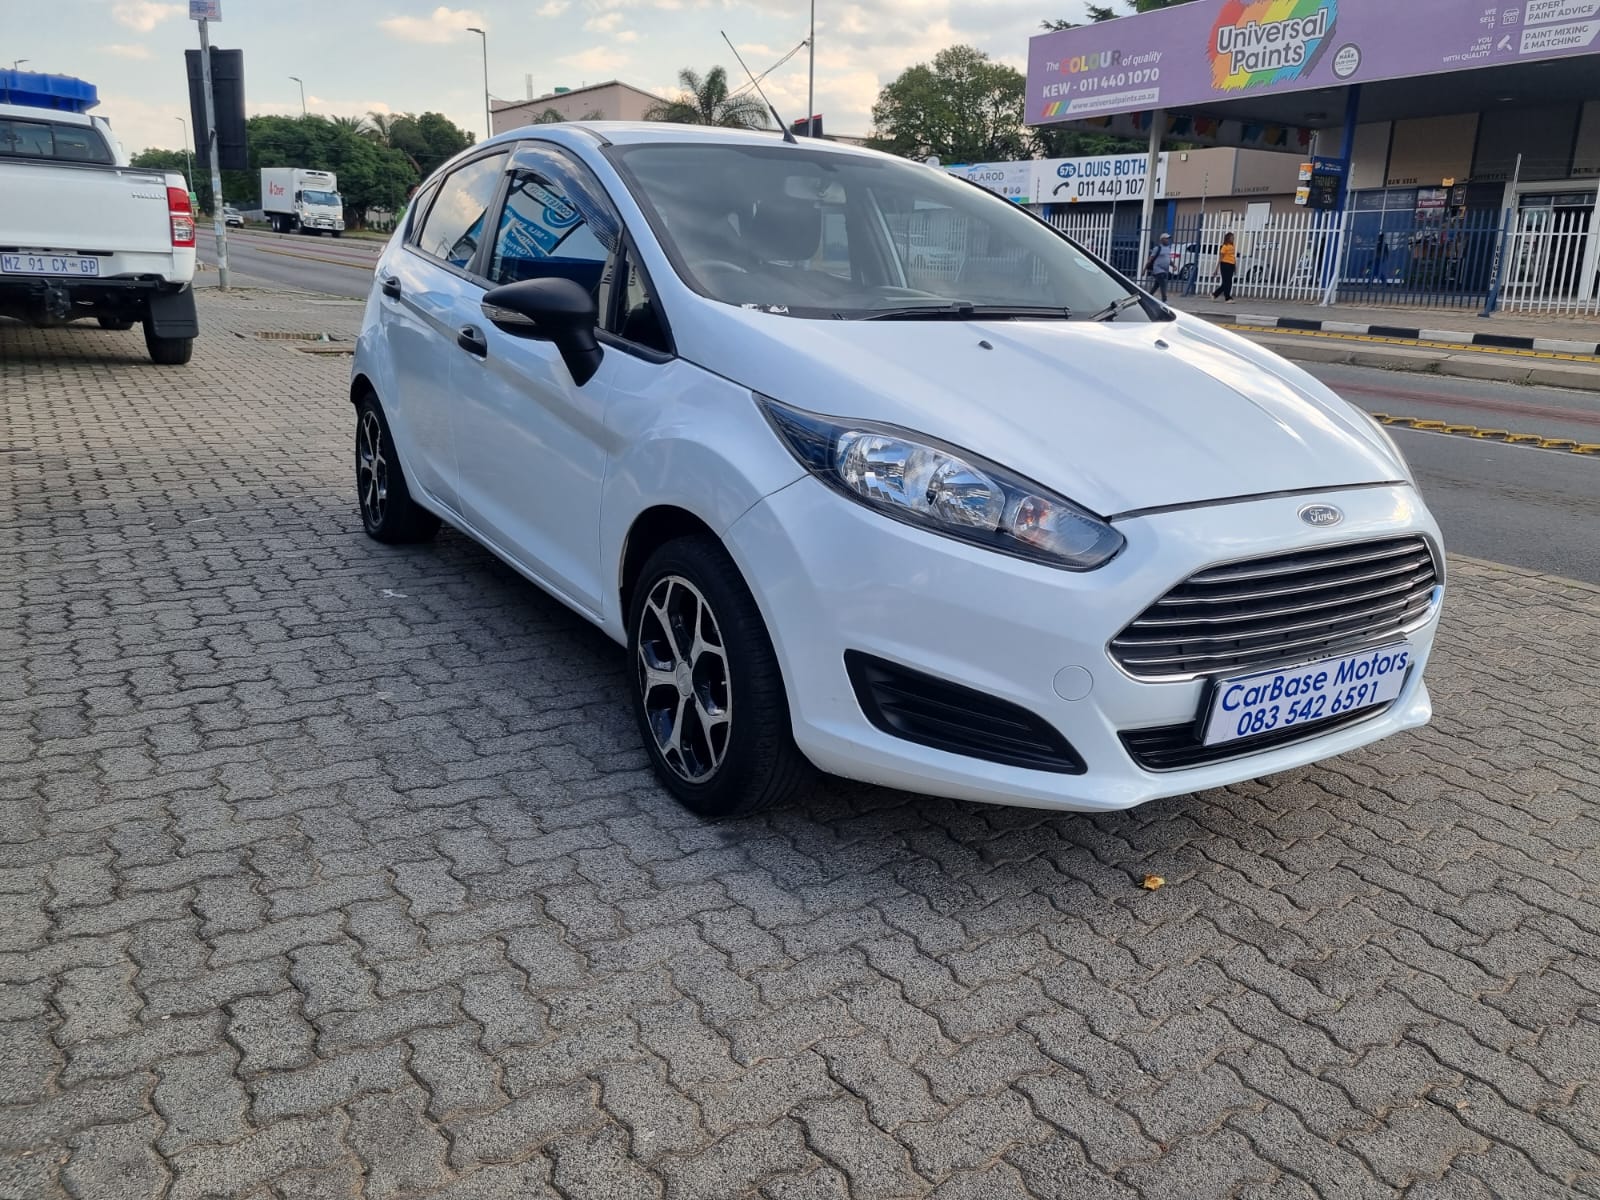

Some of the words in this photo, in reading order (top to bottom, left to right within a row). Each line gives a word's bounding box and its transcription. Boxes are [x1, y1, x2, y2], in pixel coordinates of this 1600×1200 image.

[1528, 10, 1556, 21] PAINT
[1558, 4, 1594, 16] ADVICE
[1529, 0, 1564, 11] EXPERT
[1218, 9, 1327, 52] Universal
[1525, 30, 1553, 40] PAINT
[1554, 25, 1589, 36] MIXING
[1531, 36, 1581, 49] MATCHING
[1046, 62, 1060, 72] The
[1061, 50, 1121, 75] COLOUR
[1122, 54, 1134, 66] of
[1132, 50, 1162, 66] quality
[1231, 42, 1304, 74] Paints
[1461, 50, 1491, 60] QUALITY
[1042, 82, 1071, 98] KEW
[1080, 77, 1098, 92] 011
[1101, 74, 1125, 89] 440
[1128, 68, 1160, 85] 1070
[1077, 160, 1111, 178] LOUIS
[1114, 158, 1148, 176] BOTH
[1078, 180, 1095, 197] 011
[1098, 179, 1122, 196] 440
[4, 256, 21, 270] MZ
[29, 257, 44, 271] 91
[52, 258, 68, 272] CX
[80, 260, 96, 273] GP
[1310, 508, 1335, 522] Ford
[1222, 671, 1328, 712] CarBase
[1333, 651, 1409, 687] Motors
[1237, 706, 1279, 736] 083
[1284, 694, 1327, 725] 542
[1331, 681, 1379, 714] 6591
